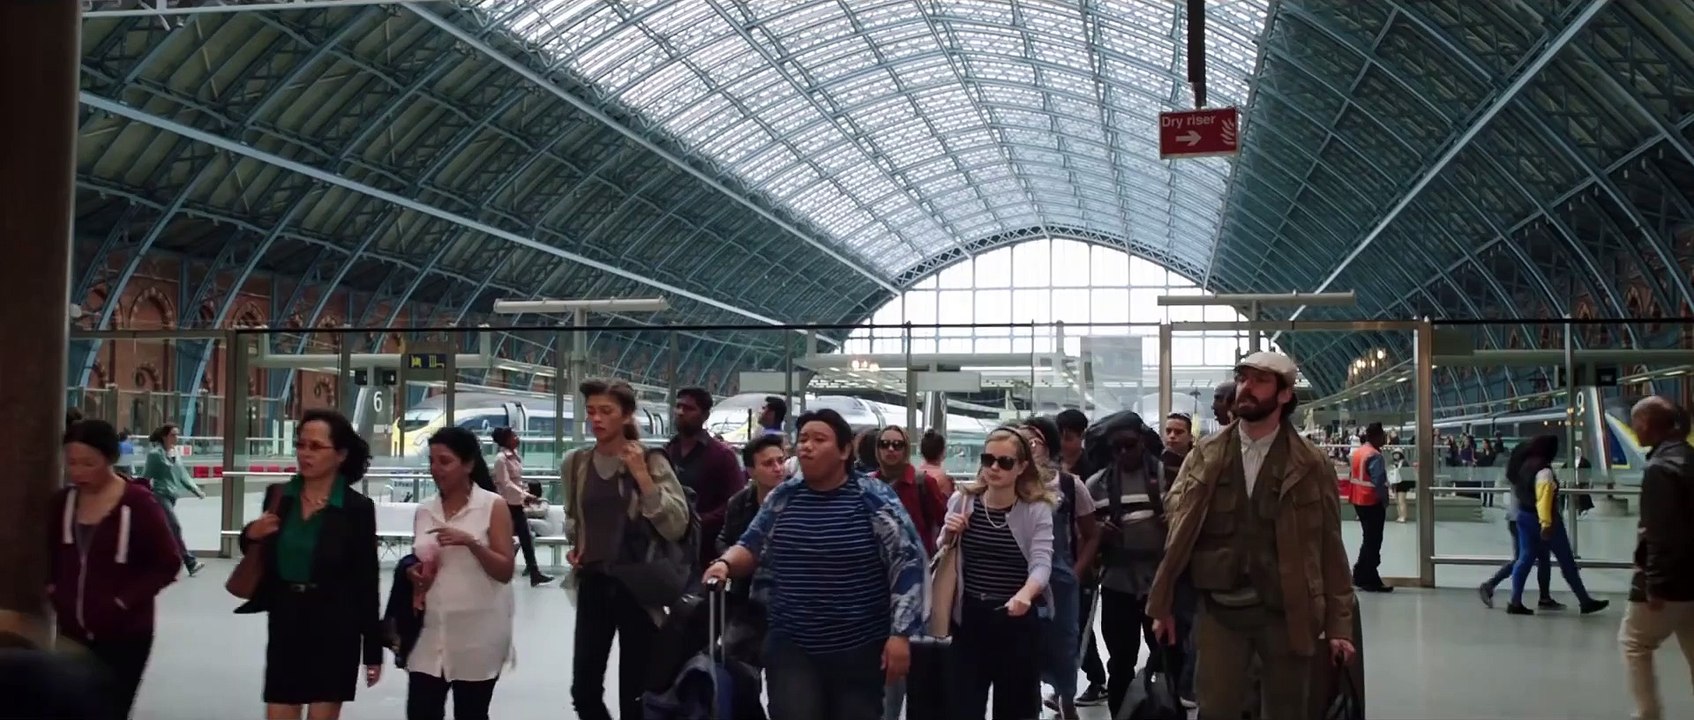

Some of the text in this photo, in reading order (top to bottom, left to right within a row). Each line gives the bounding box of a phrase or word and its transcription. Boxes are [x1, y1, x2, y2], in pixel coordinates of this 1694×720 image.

[1162, 114, 1216, 129] Dry riser
[373, 390, 382, 412] 6
[1576, 391, 1585, 416] 9
